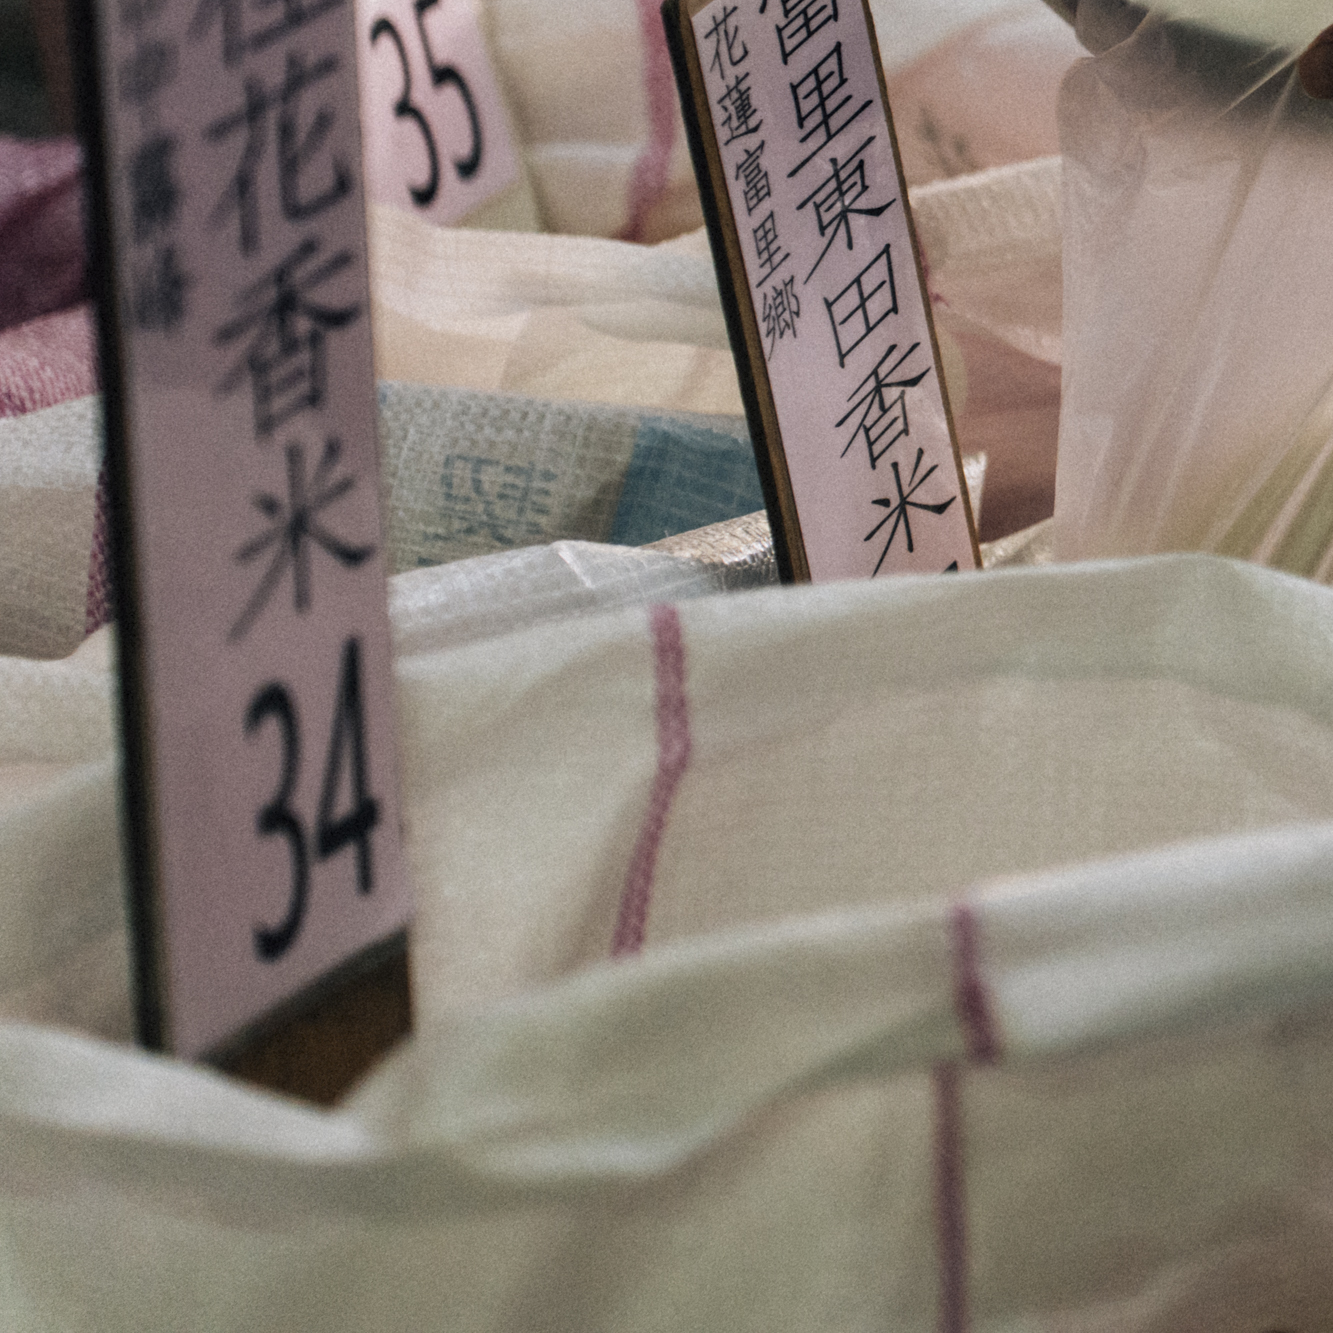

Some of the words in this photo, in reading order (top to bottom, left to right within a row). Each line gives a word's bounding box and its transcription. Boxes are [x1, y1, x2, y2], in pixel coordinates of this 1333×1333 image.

[703, 6, 801, 361] 花蓮富里鄉
[242, 634, 380, 963] 34
